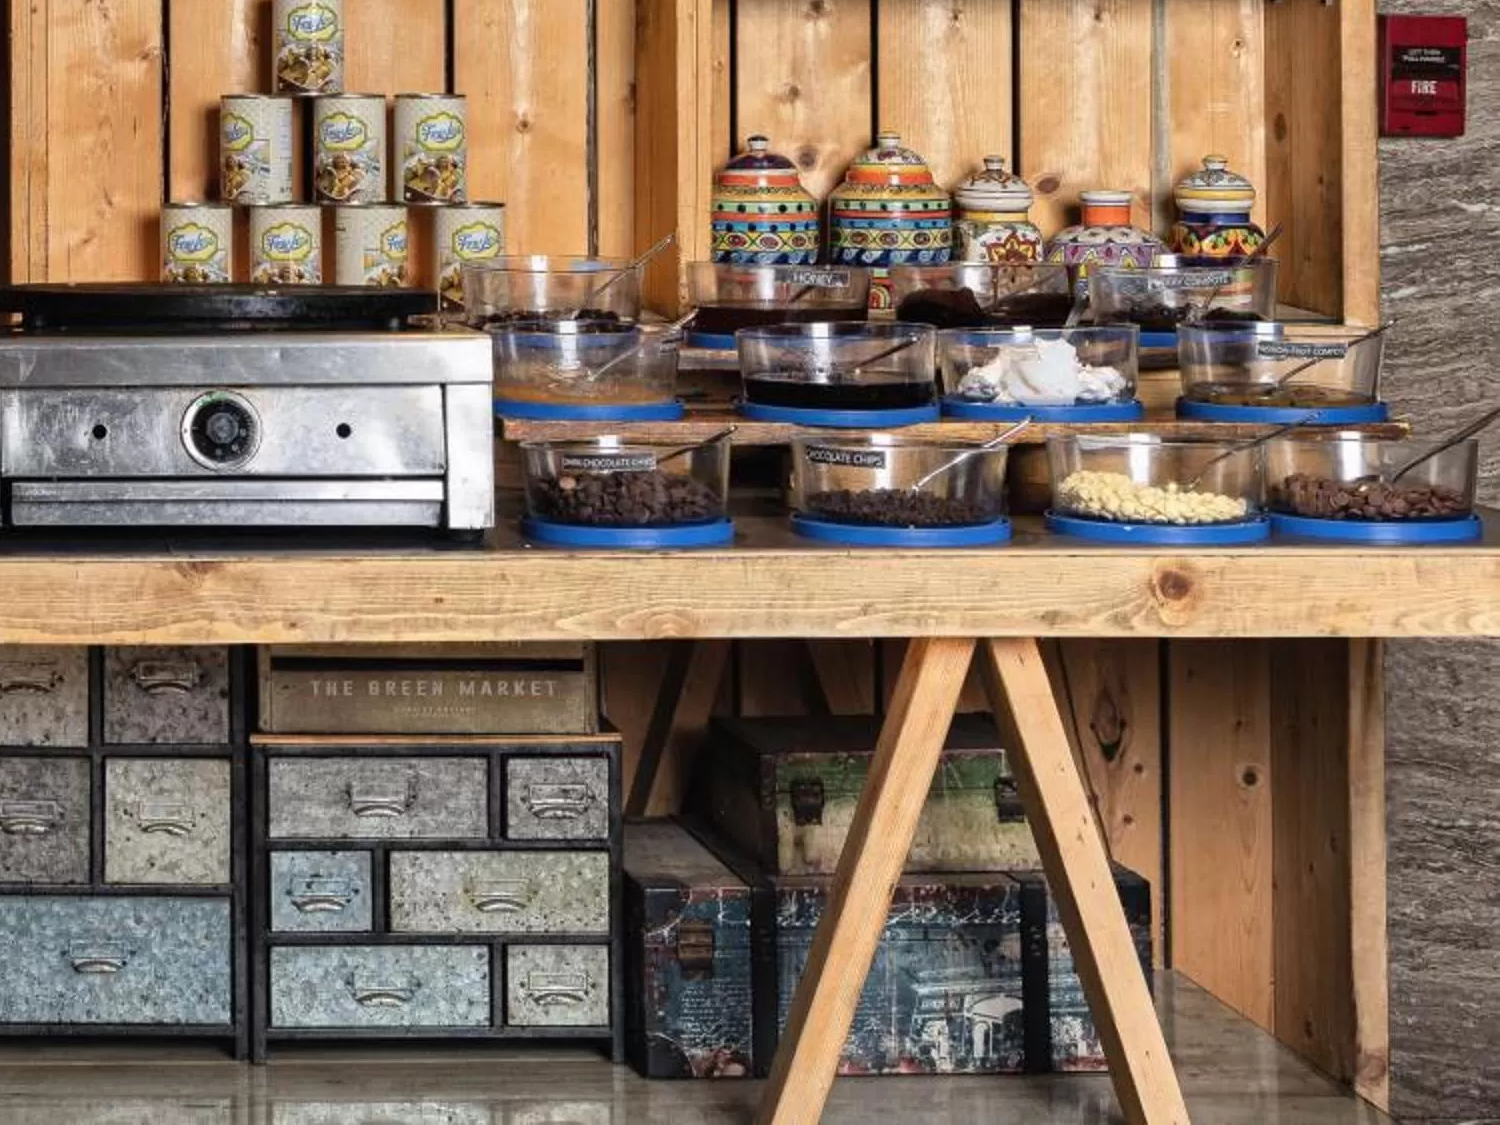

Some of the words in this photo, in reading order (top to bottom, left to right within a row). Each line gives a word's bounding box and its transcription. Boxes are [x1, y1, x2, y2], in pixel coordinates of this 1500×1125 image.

[1411, 80, 1437, 94] FIRE
[310, 680, 353, 696] THE
[459, 679, 558, 696] MARKET
